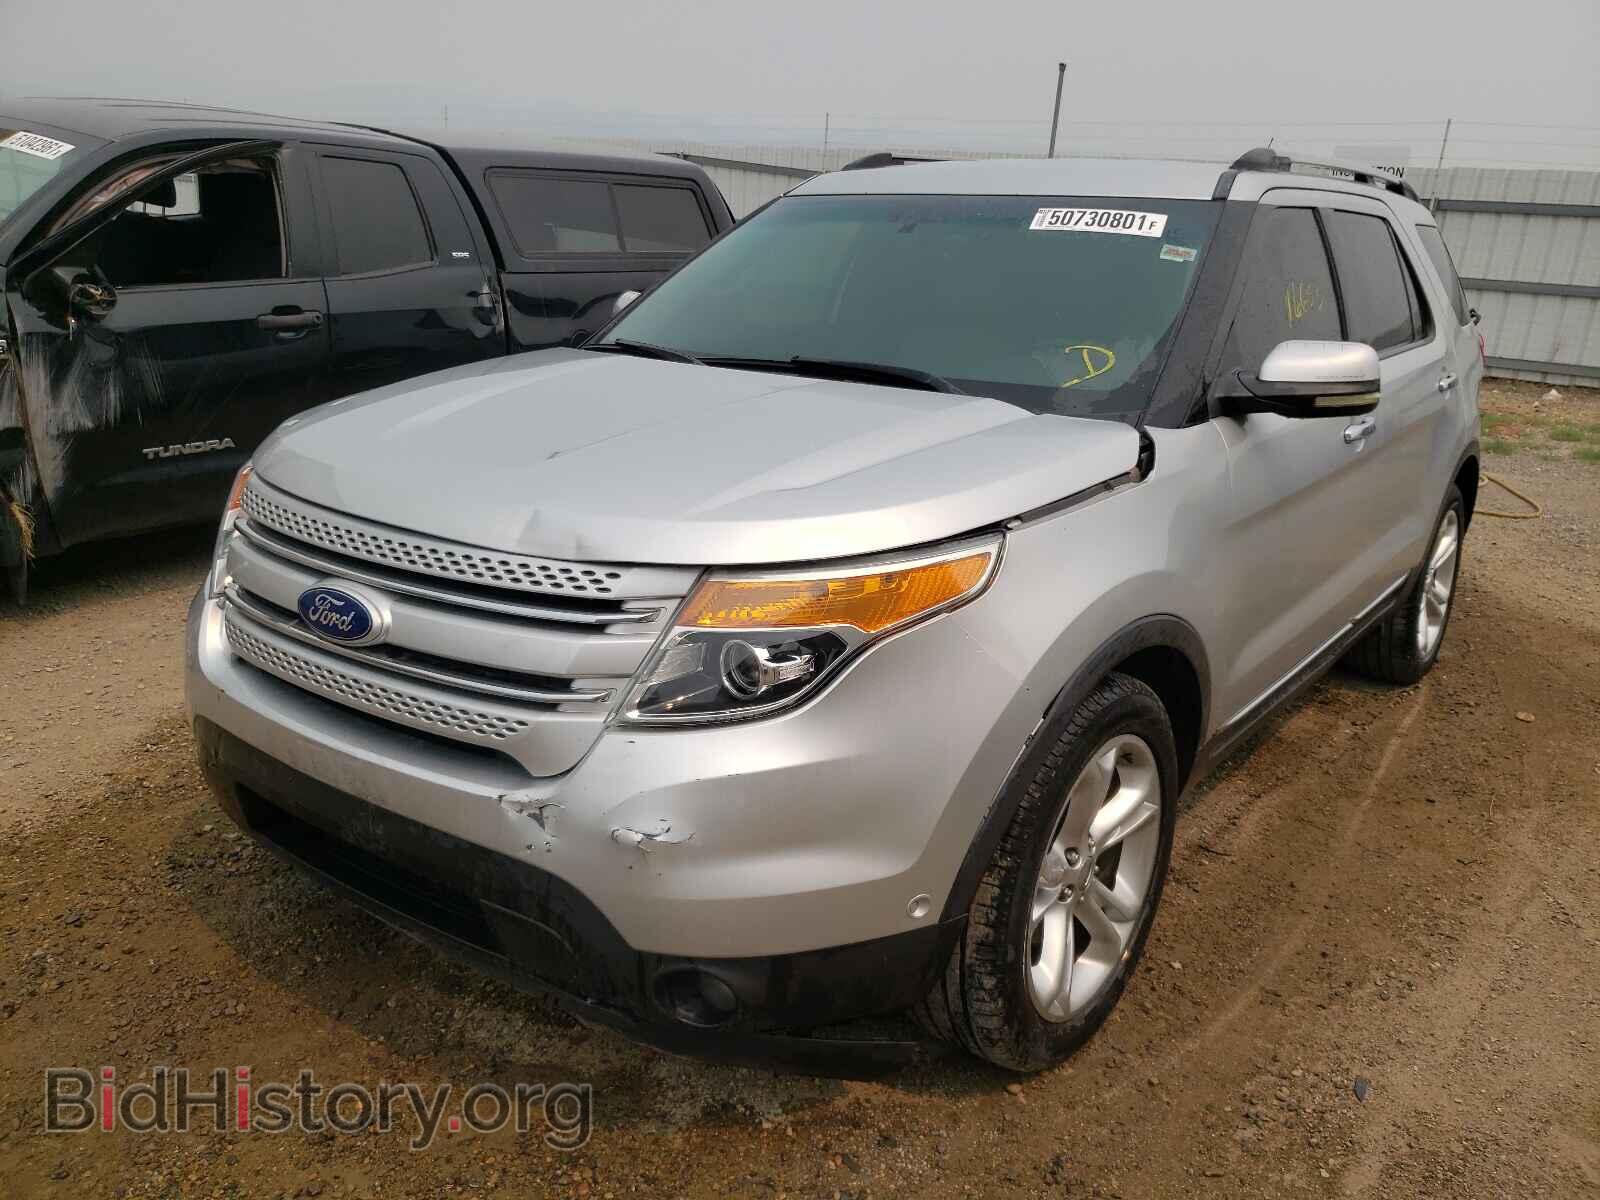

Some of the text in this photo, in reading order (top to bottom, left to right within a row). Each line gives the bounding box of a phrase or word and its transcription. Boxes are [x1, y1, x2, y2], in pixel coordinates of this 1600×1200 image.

[1049, 204, 1147, 232] 50730801
[1148, 220, 1158, 231] F
[142, 437, 236, 459] TUNDRA
[309, 593, 357, 632] Ford
